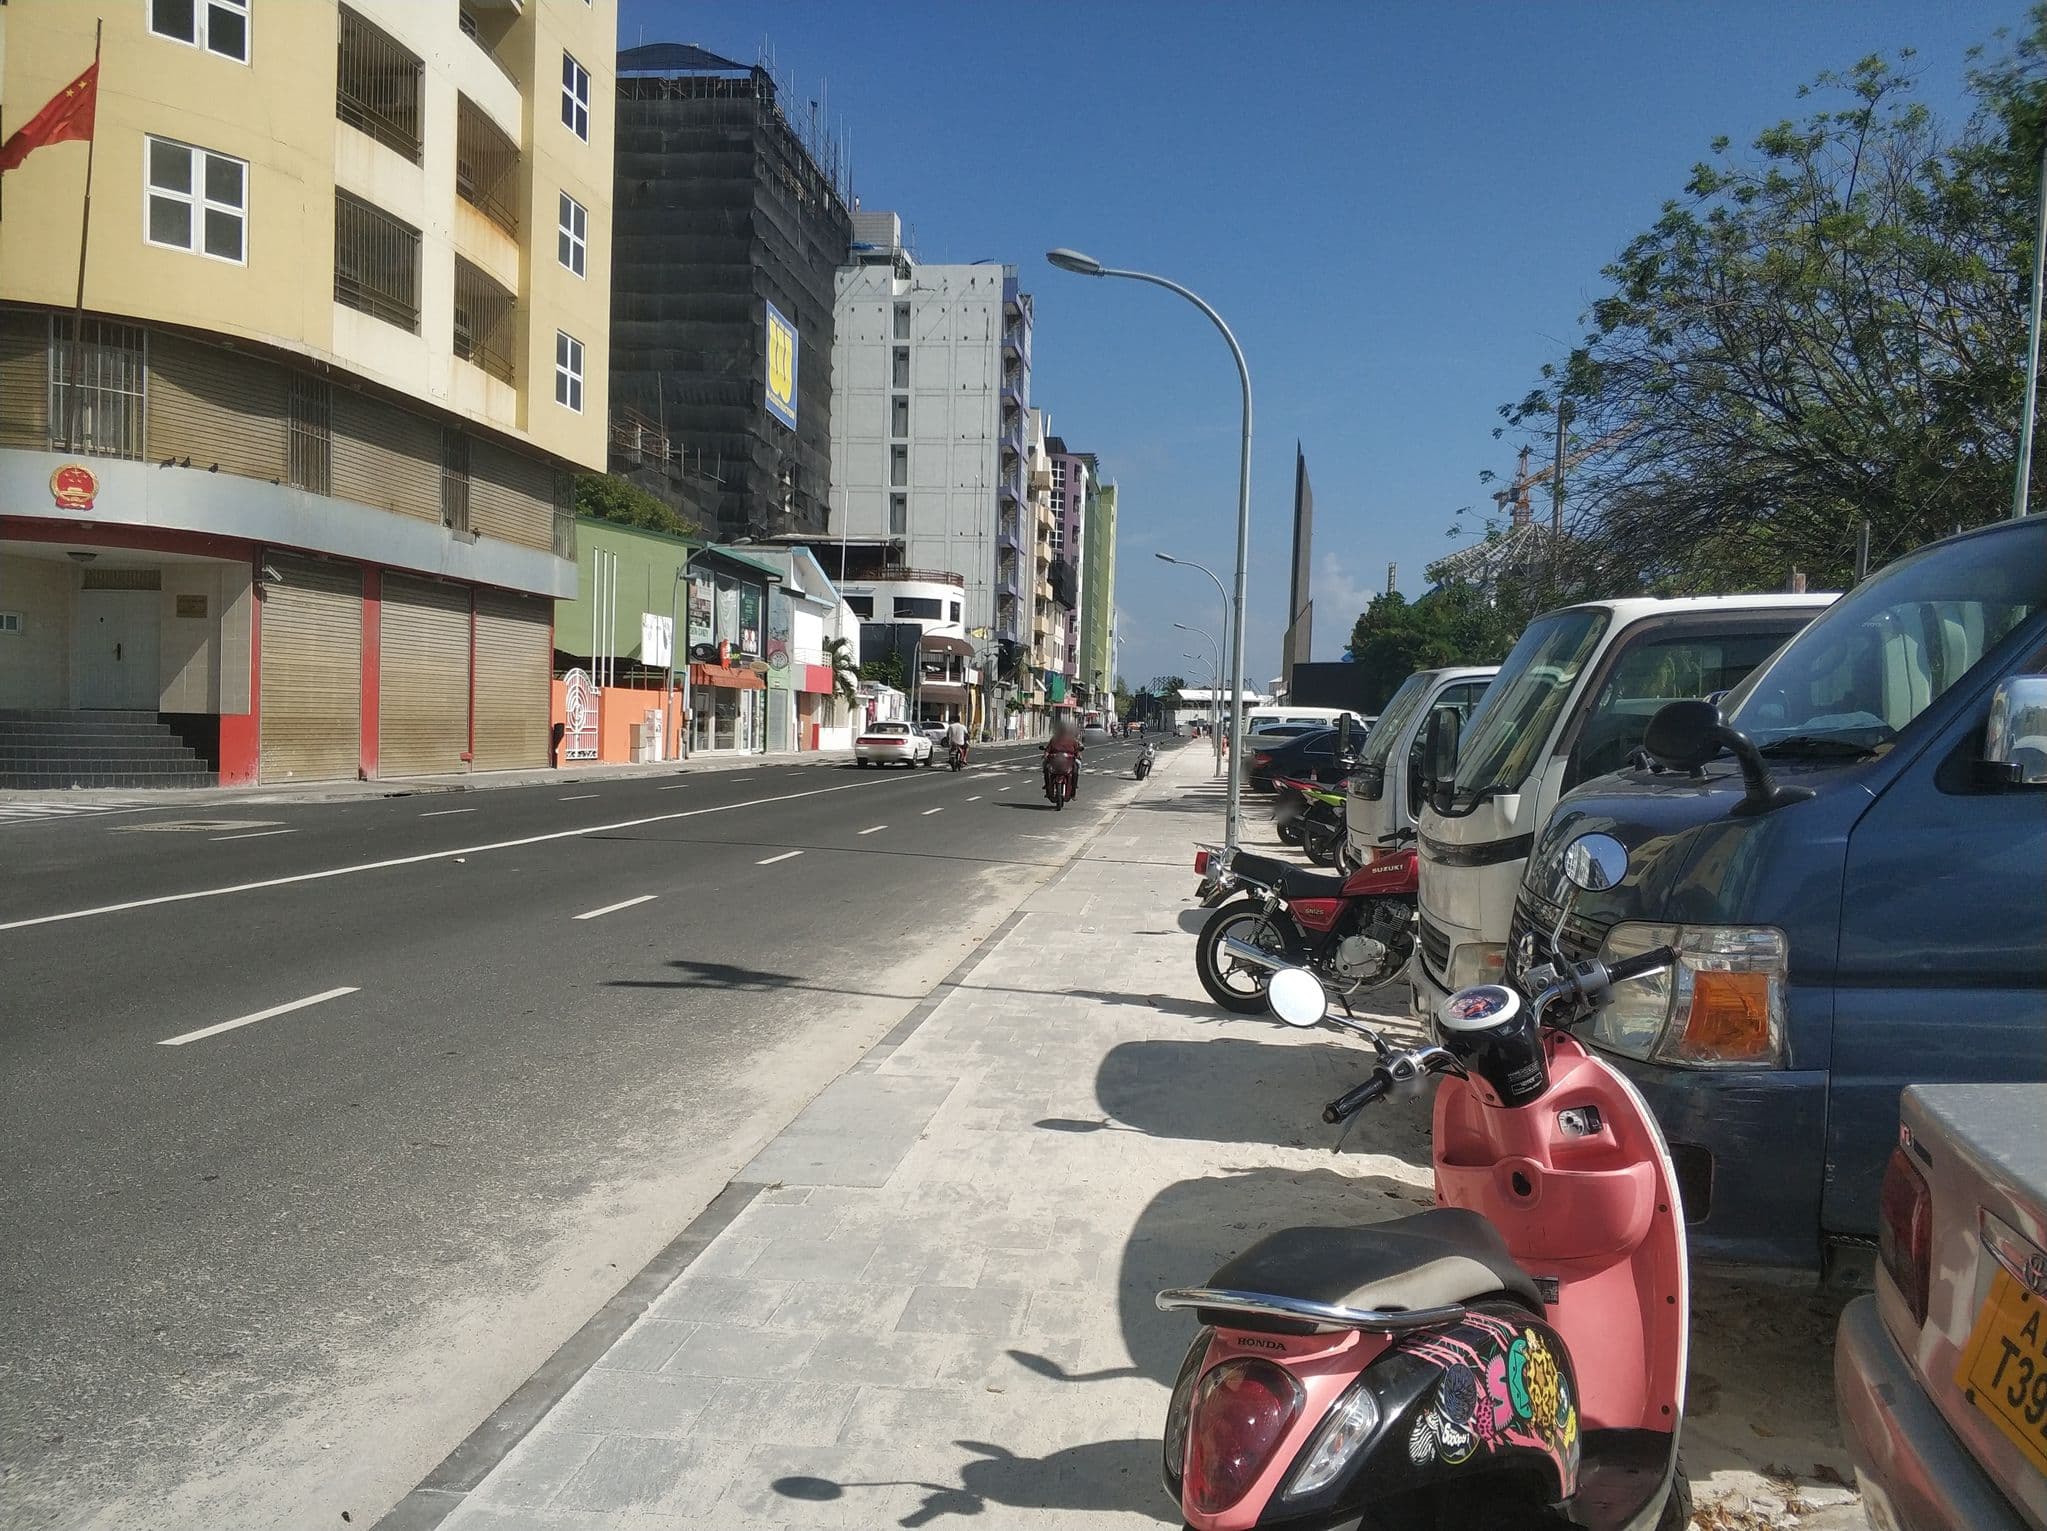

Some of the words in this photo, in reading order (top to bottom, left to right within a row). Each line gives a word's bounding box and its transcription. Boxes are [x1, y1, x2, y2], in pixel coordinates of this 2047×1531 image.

[1371, 864, 1403, 874] SUZUKI
[1237, 1336, 1287, 1351] HONDA
[1991, 1335, 2047, 1439] T39
